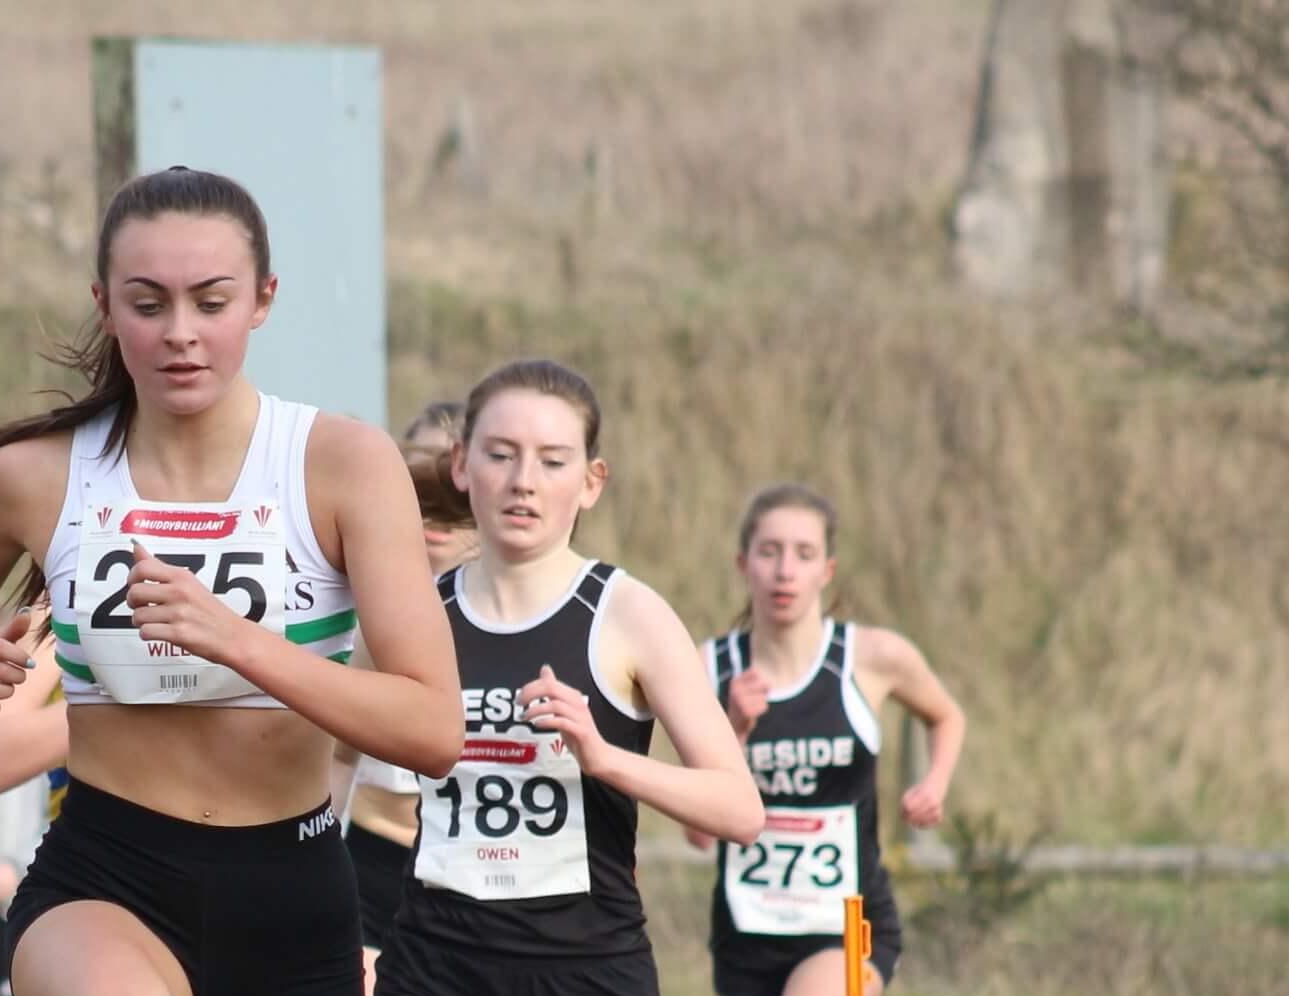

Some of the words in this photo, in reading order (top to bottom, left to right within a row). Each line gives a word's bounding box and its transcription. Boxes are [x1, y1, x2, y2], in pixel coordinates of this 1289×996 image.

[435, 774, 569, 838] 189
[477, 848, 520, 860] OWEN
[738, 842, 844, 888] 273
